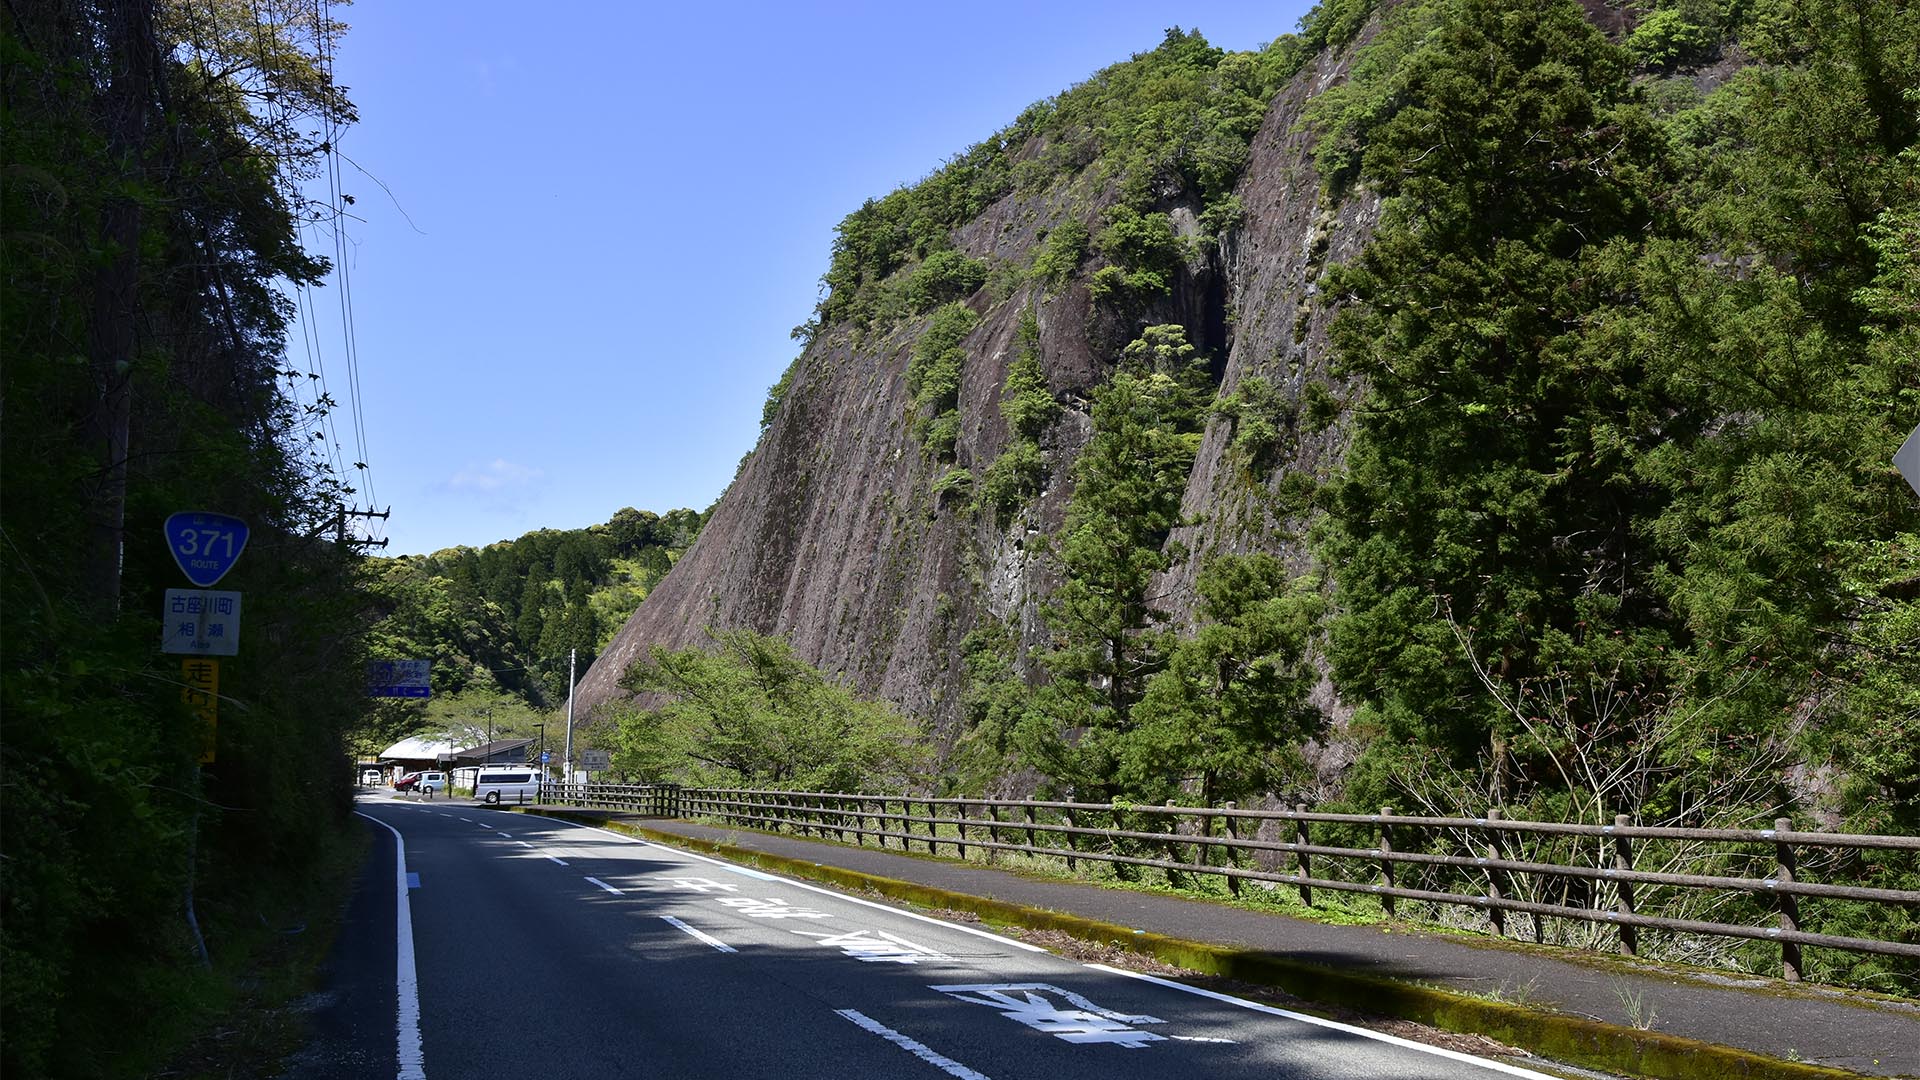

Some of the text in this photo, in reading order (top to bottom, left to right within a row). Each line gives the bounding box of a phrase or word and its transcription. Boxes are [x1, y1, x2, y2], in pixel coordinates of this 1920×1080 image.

[178, 528, 234, 558] 371
[190, 559, 220, 570] ROUTE
[171, 595, 233, 616] 古座川町
